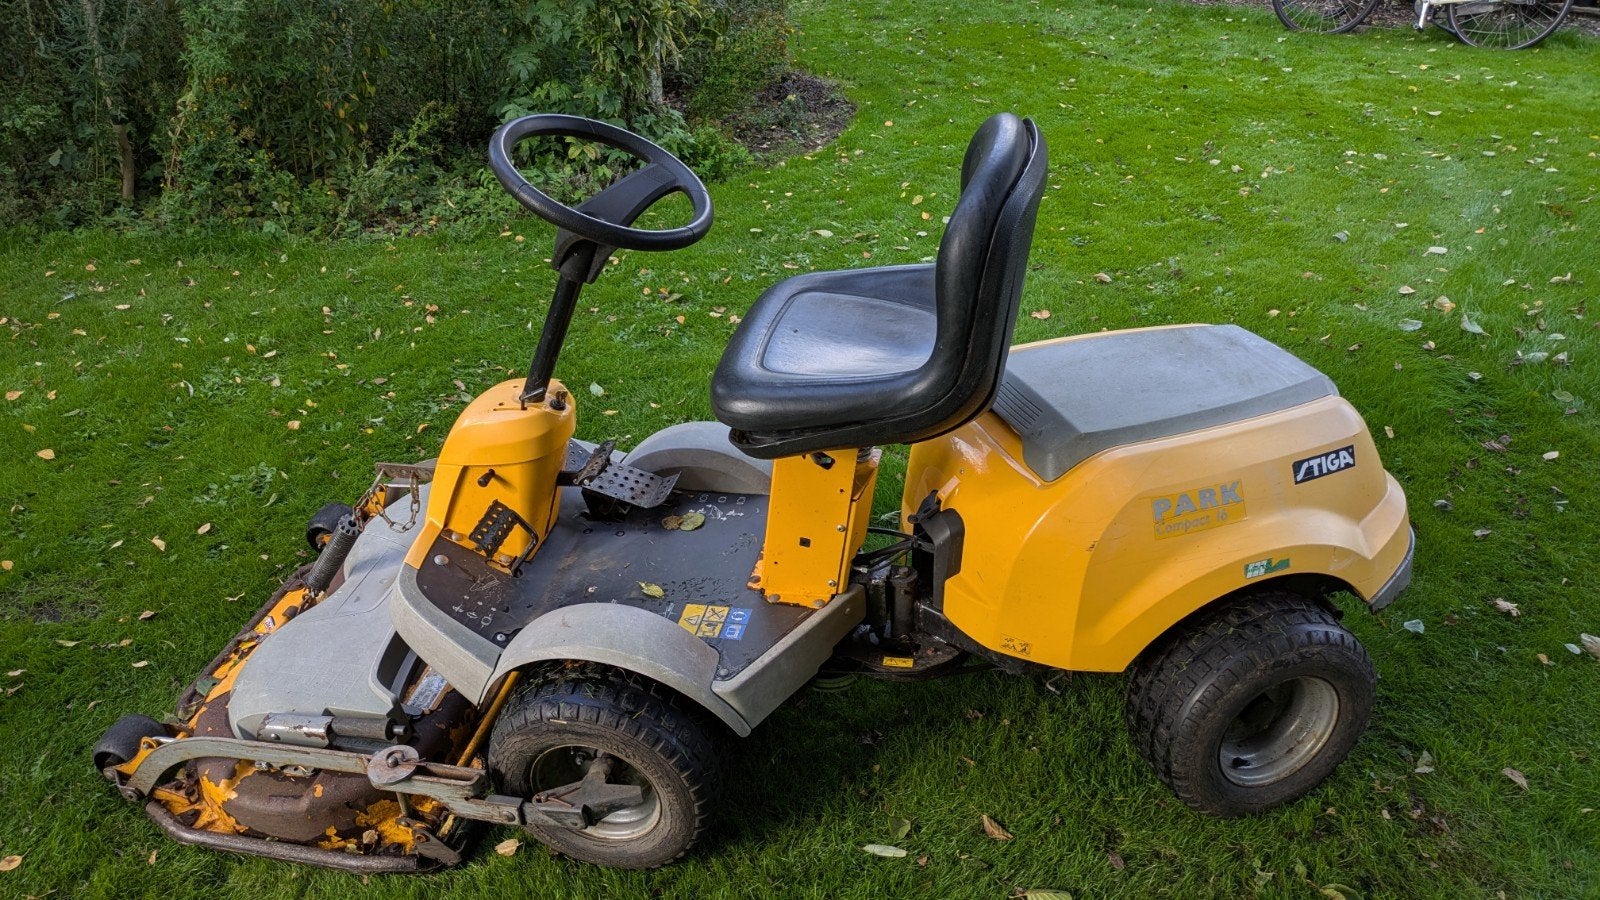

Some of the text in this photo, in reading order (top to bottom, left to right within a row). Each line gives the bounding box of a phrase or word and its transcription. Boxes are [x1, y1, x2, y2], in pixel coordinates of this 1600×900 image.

[1296, 450, 1354, 482] STIGA
[1153, 480, 1243, 521] PARK
[1155, 514, 1211, 536] Compact
